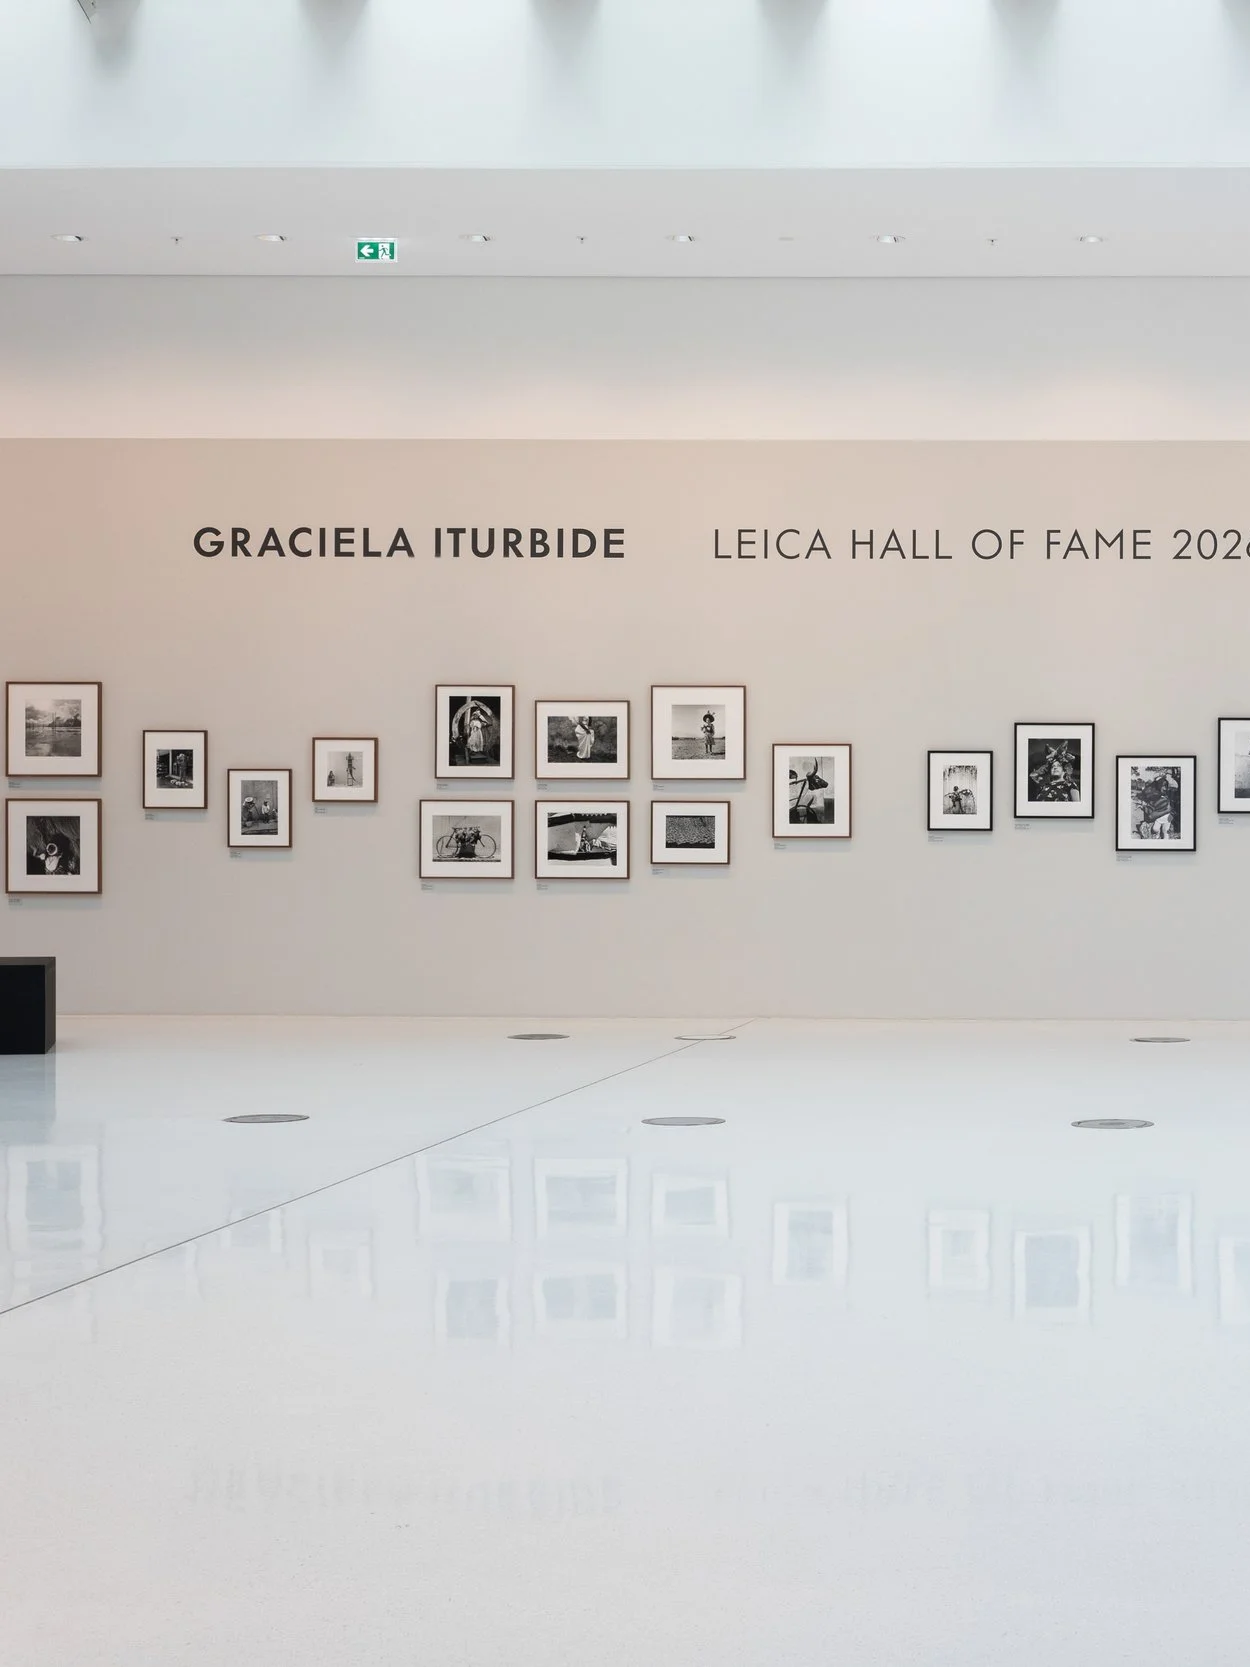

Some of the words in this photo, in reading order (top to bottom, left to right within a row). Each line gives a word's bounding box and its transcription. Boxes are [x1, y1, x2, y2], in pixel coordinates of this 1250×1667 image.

[193, 526, 416, 560] GRACIELA
[434, 526, 625, 559] ITURBIDE
[714, 528, 832, 560] LEICA
[851, 528, 953, 560] HALL
[971, 528, 1025, 561] OF
[1046, 528, 1152, 560] FAME
